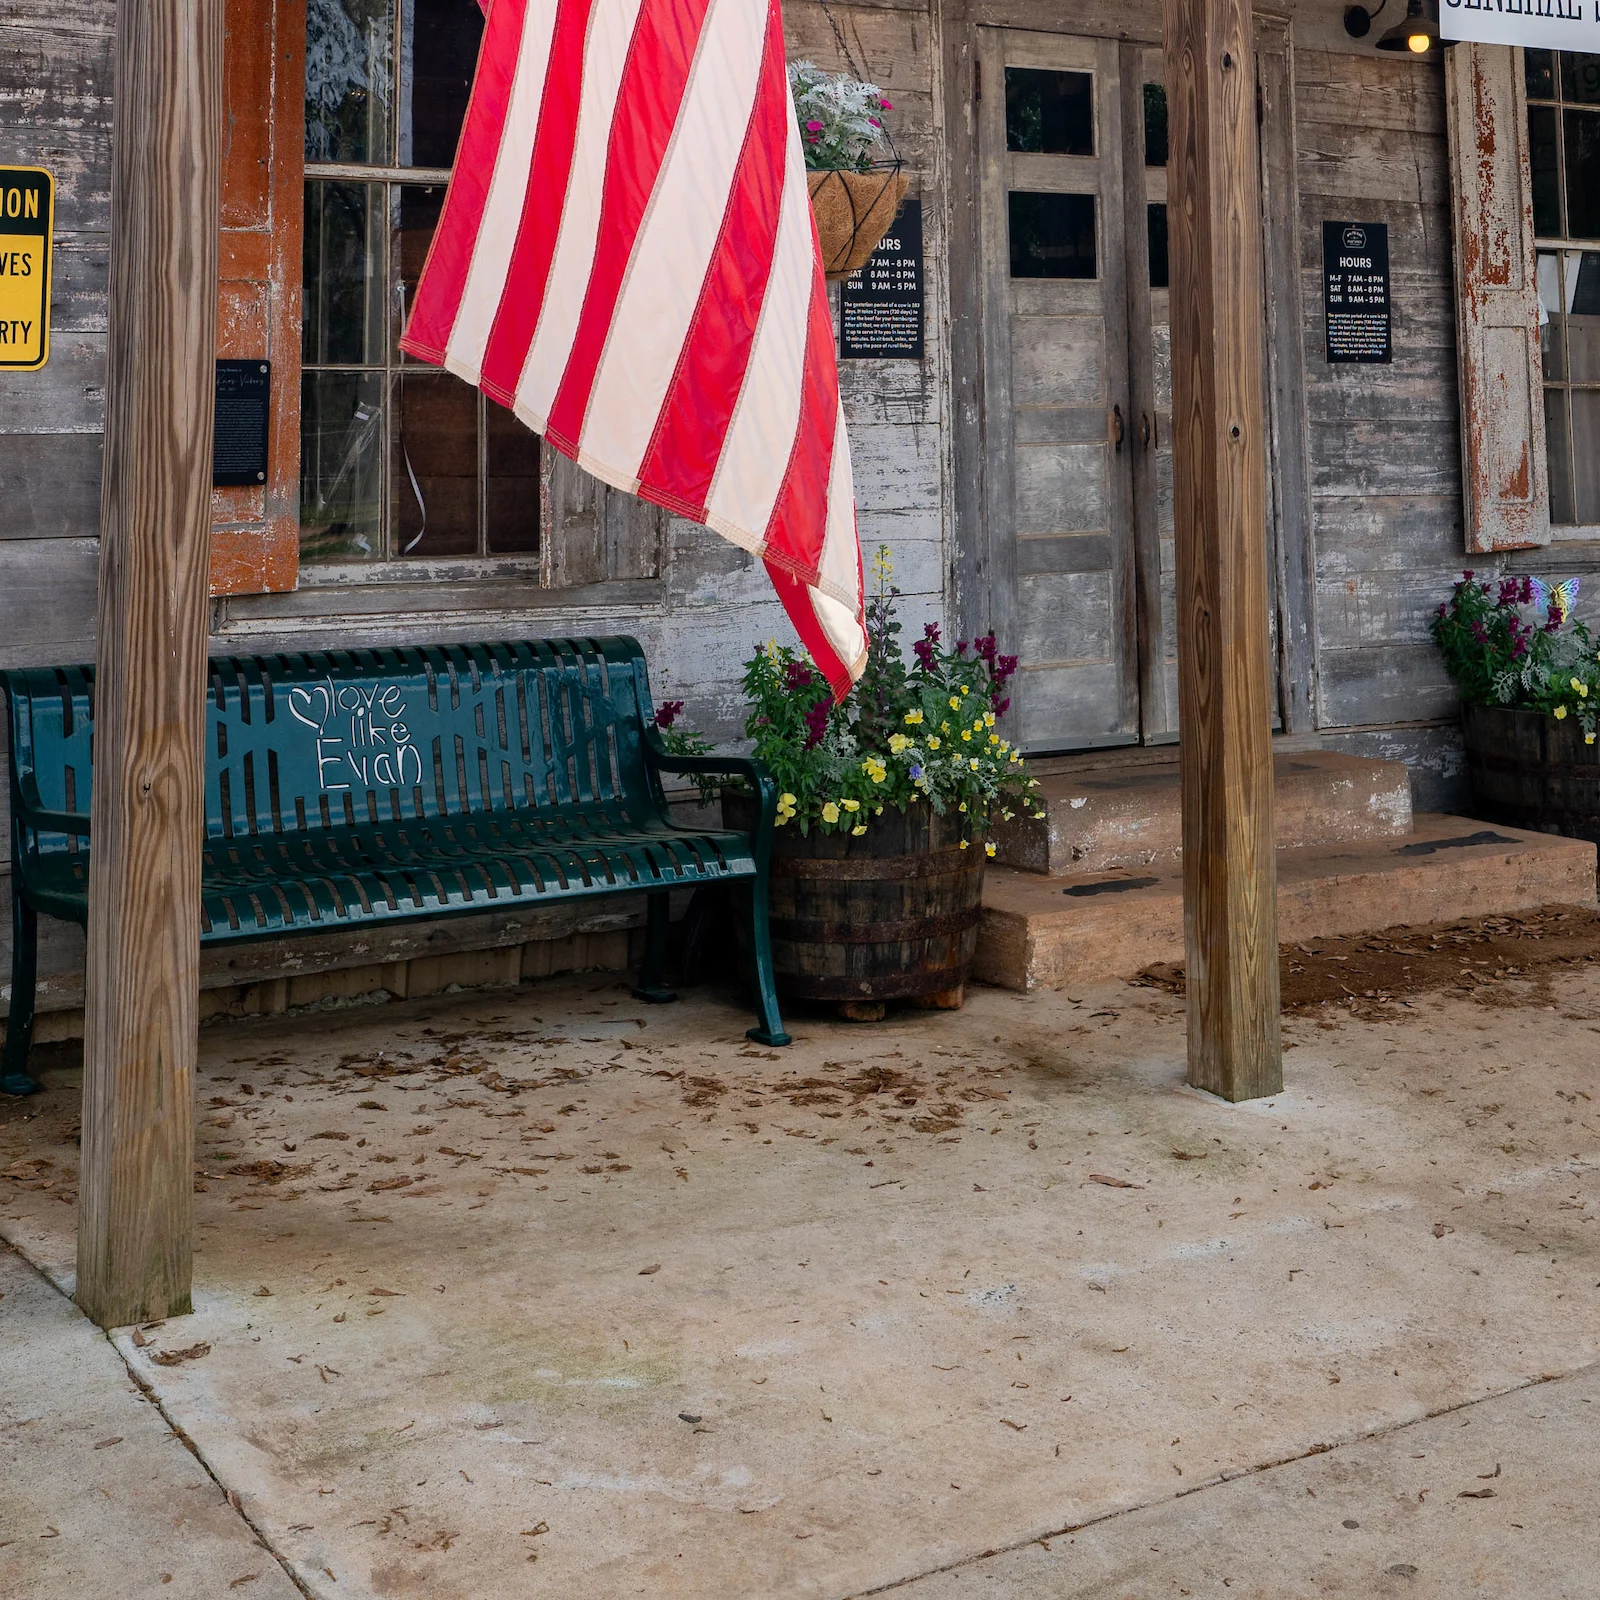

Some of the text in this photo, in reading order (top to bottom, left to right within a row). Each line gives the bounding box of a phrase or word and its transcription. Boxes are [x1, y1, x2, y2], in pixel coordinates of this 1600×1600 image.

[874, 239, 901, 250] URS
[871, 259, 875, 267] 7
[877, 259, 890, 267] AM
[897, 259, 901, 267] 8
[903, 259, 915, 267] PM
[1340, 257, 1372, 268] HOURS
[870, 270, 875, 279] 8
[877, 270, 890, 279] AM
[897, 270, 901, 279] 8
[903, 270, 915, 279] PM
[1348, 275, 1352, 283] 7
[1352, 275, 1363, 283] AM
[1368, 275, 1372, 283] 8
[1374, 275, 1383, 283] PM
[848, 282, 863, 290] SUN
[872, 282, 876, 290] 9
[878, 282, 890, 290] AM
[898, 282, 902, 290] 5
[904, 282, 916, 290] PM
[1348, 285, 1352, 293] 8
[1352, 285, 1363, 293] AM
[1368, 285, 1372, 293] 8
[1374, 285, 1383, 293] PM
[327, 675, 407, 718] love
[352, 708, 411, 748] like
[317, 738, 422, 789] Evan
